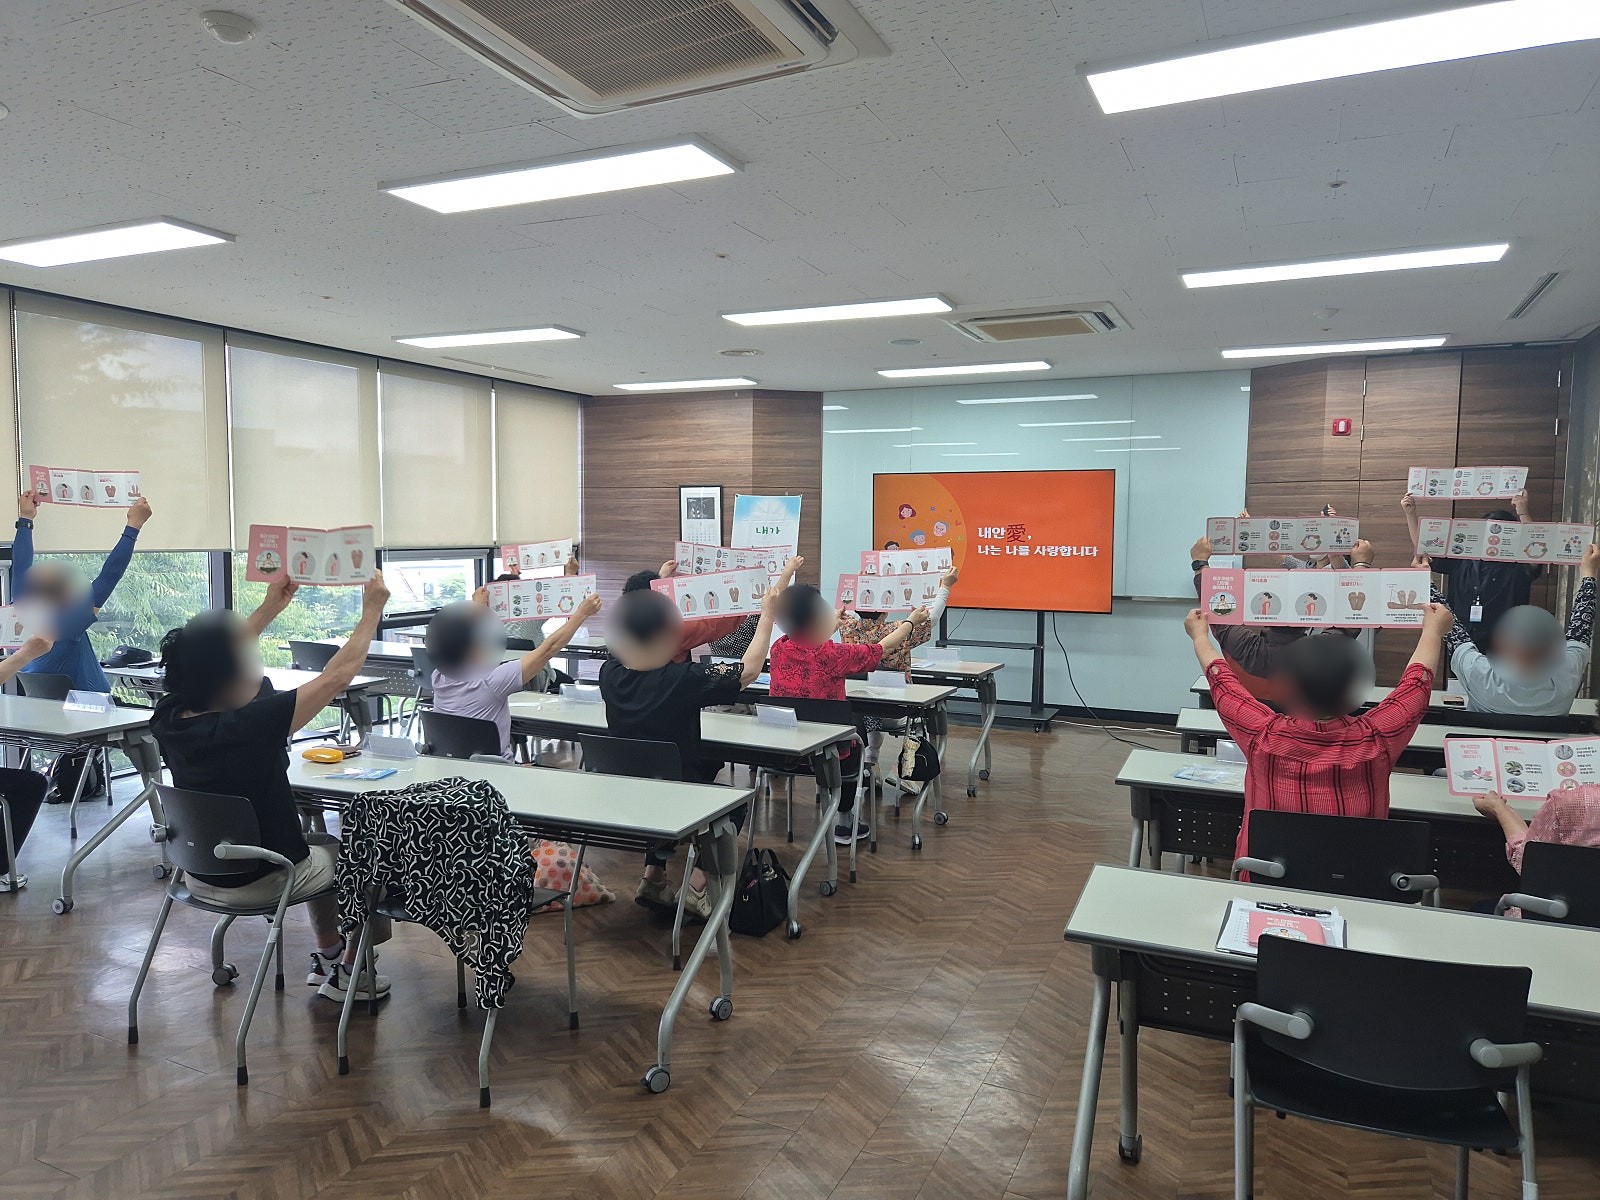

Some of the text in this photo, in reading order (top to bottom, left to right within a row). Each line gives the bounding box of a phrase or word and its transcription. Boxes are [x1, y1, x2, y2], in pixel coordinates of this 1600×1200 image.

[755, 525, 781, 535] 내가
[977, 523, 1032, 543] 내안愛,
[977, 544, 1099, 557] 나는 나를 사랑합니다
